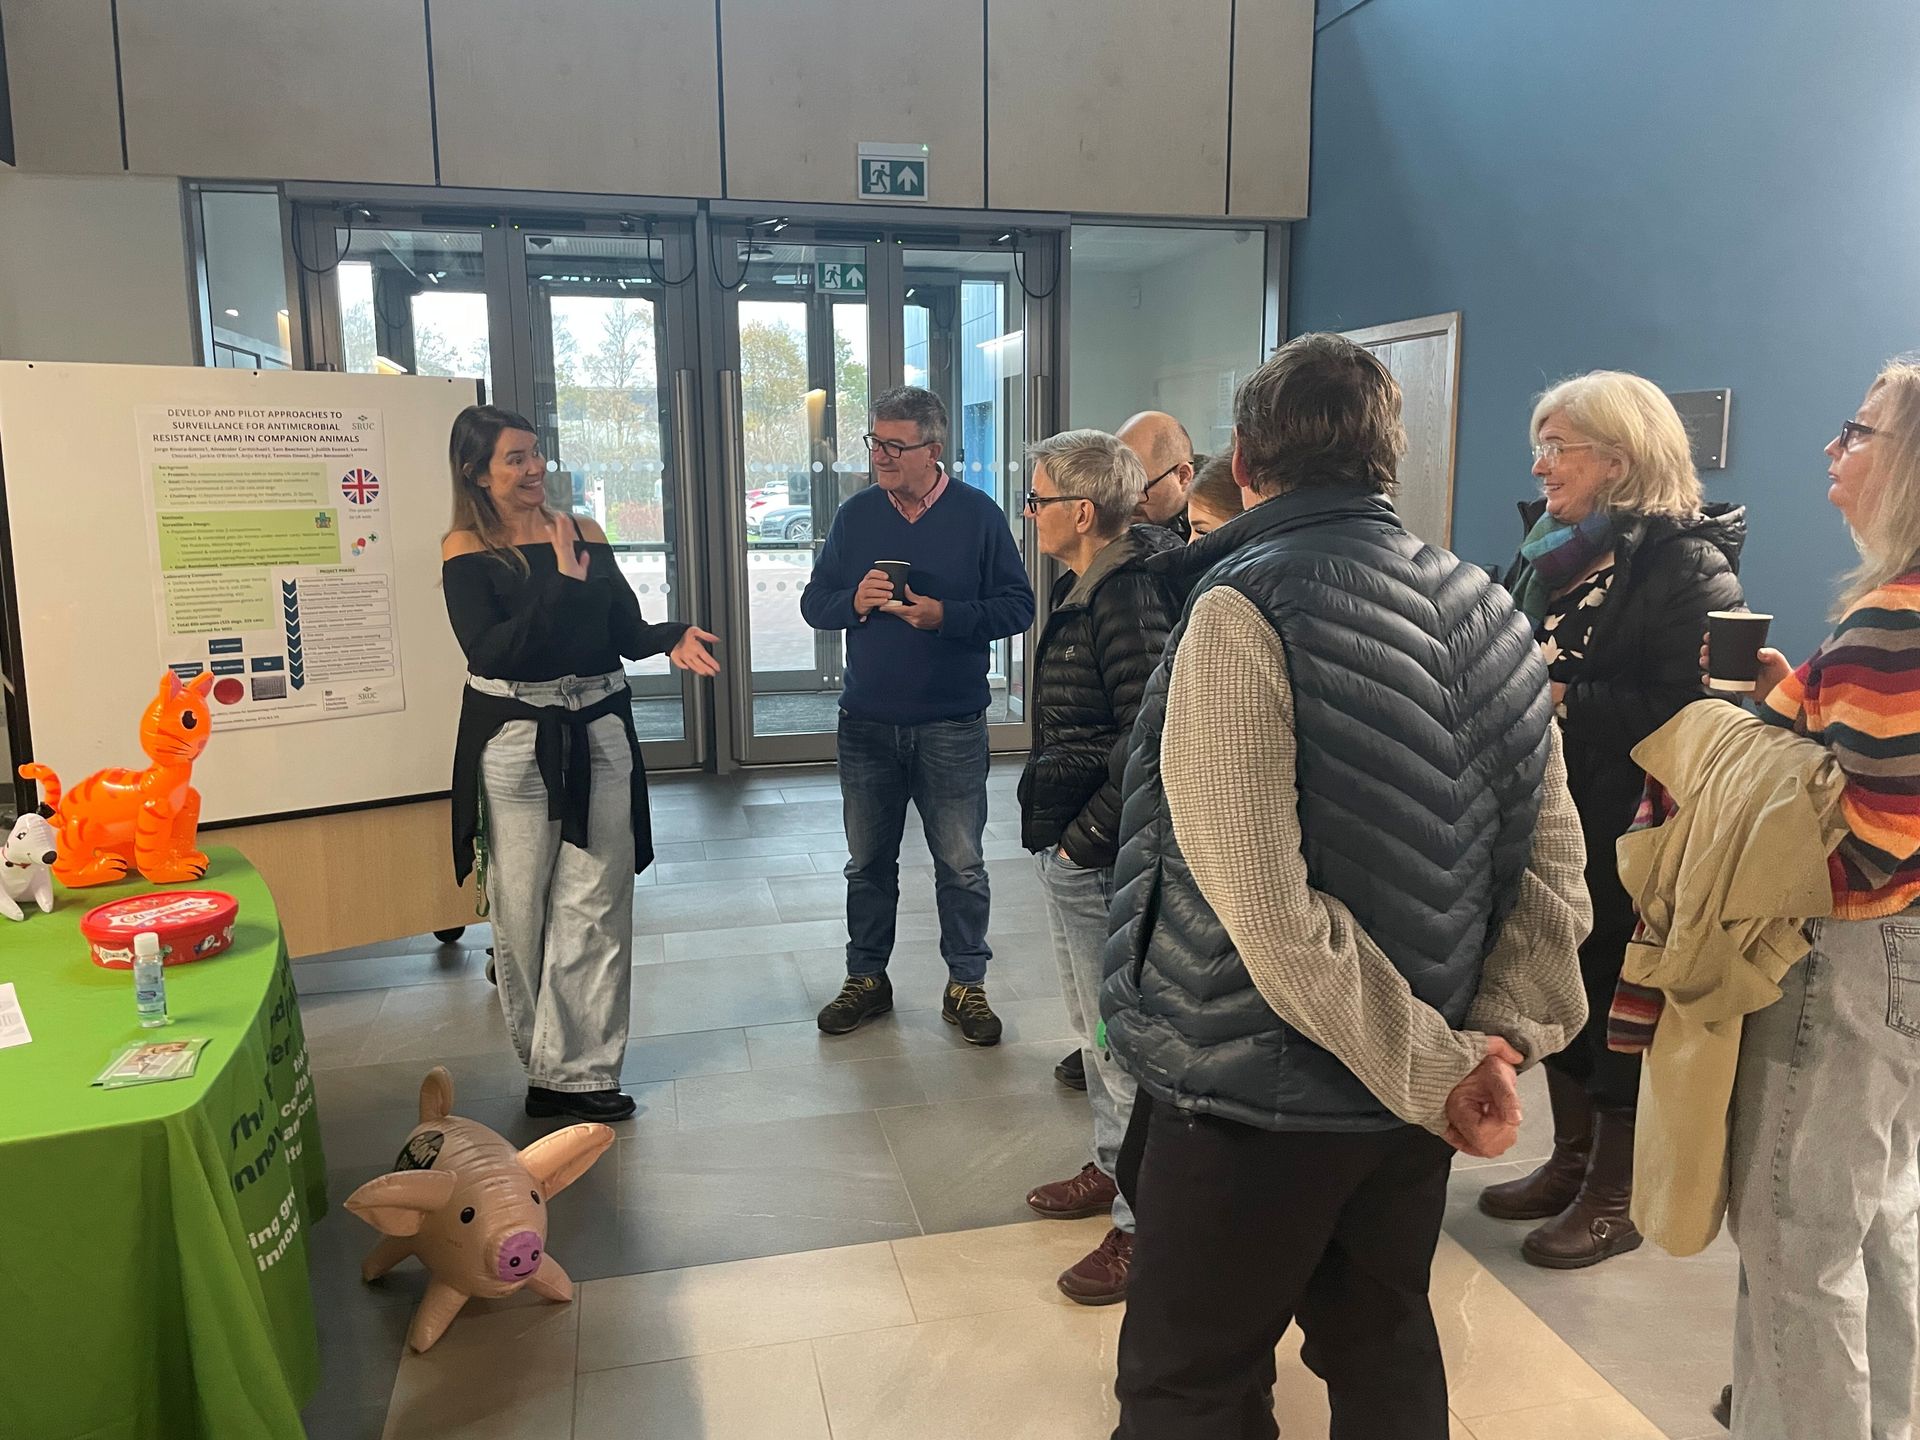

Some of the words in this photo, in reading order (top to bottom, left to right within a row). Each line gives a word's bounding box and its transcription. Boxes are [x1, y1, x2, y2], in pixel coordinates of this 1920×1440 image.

[167, 409, 212, 417] DEVELOP
[214, 410, 236, 418] AND
[238, 410, 265, 418] PILOT
[268, 410, 328, 419] APPROACHES
[330, 411, 343, 419] TO
[172, 421, 244, 430] SURVEILLANCE
[246, 422, 265, 430] FOR
[267, 422, 340, 431] ANTIMICROBIAL
[352, 422, 375, 431] SRUC
[153, 434, 212, 442] RESISTANCE
[213, 434, 243, 443] (AMR)
[244, 434, 255, 442] IN
[258, 434, 317, 443] COMPANION
[319, 435, 360, 443] ANIMALS
